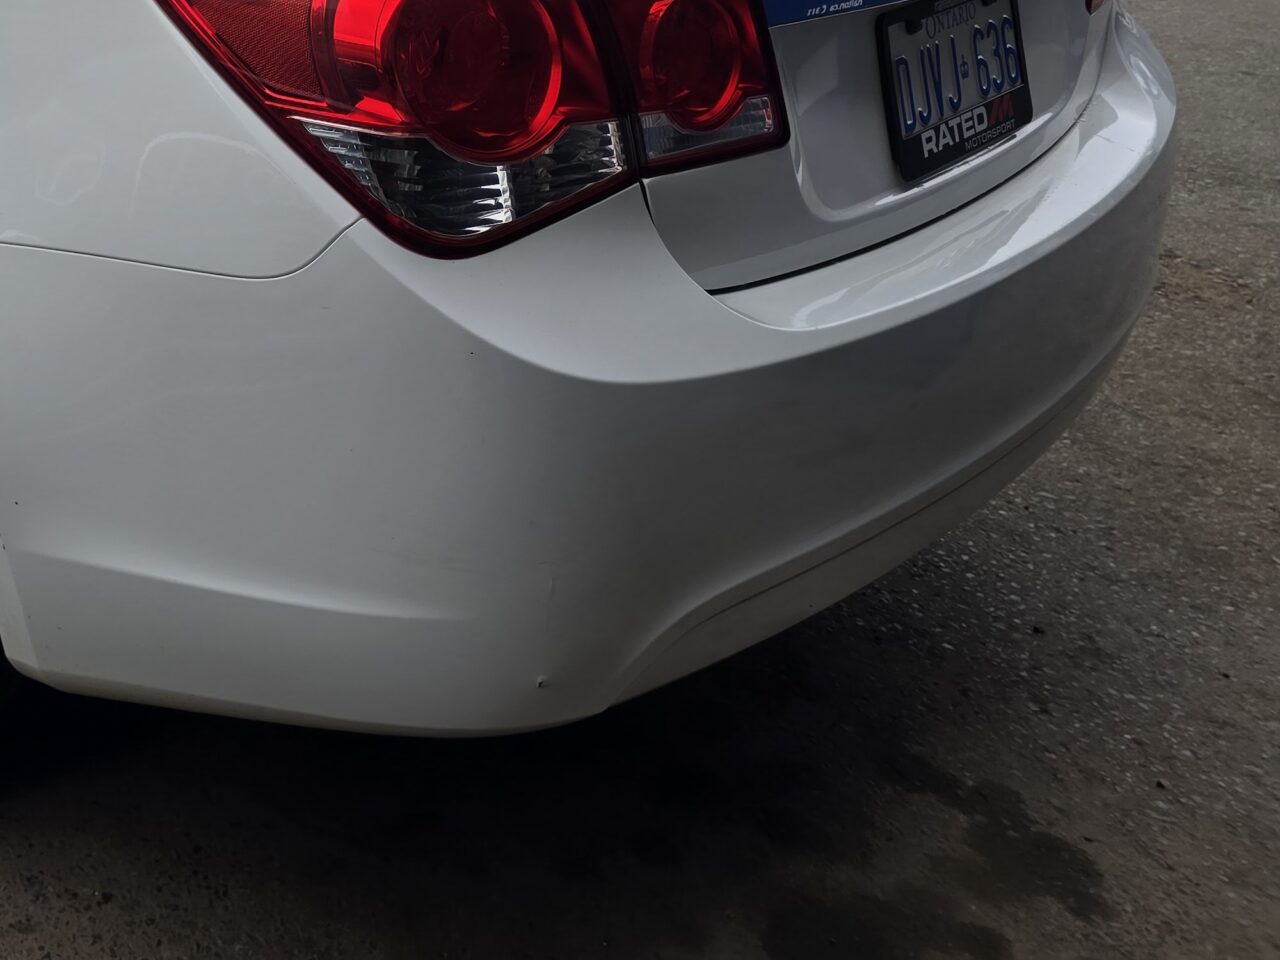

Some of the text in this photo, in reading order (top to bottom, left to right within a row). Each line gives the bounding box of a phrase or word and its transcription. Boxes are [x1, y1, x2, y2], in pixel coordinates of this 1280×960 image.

[925, 2, 976, 39] ONTARIO
[895, 14, 1020, 134] DJVJ 636
[921, 105, 989, 159] RATED
[965, 118, 1015, 151] MOTORSPORT
